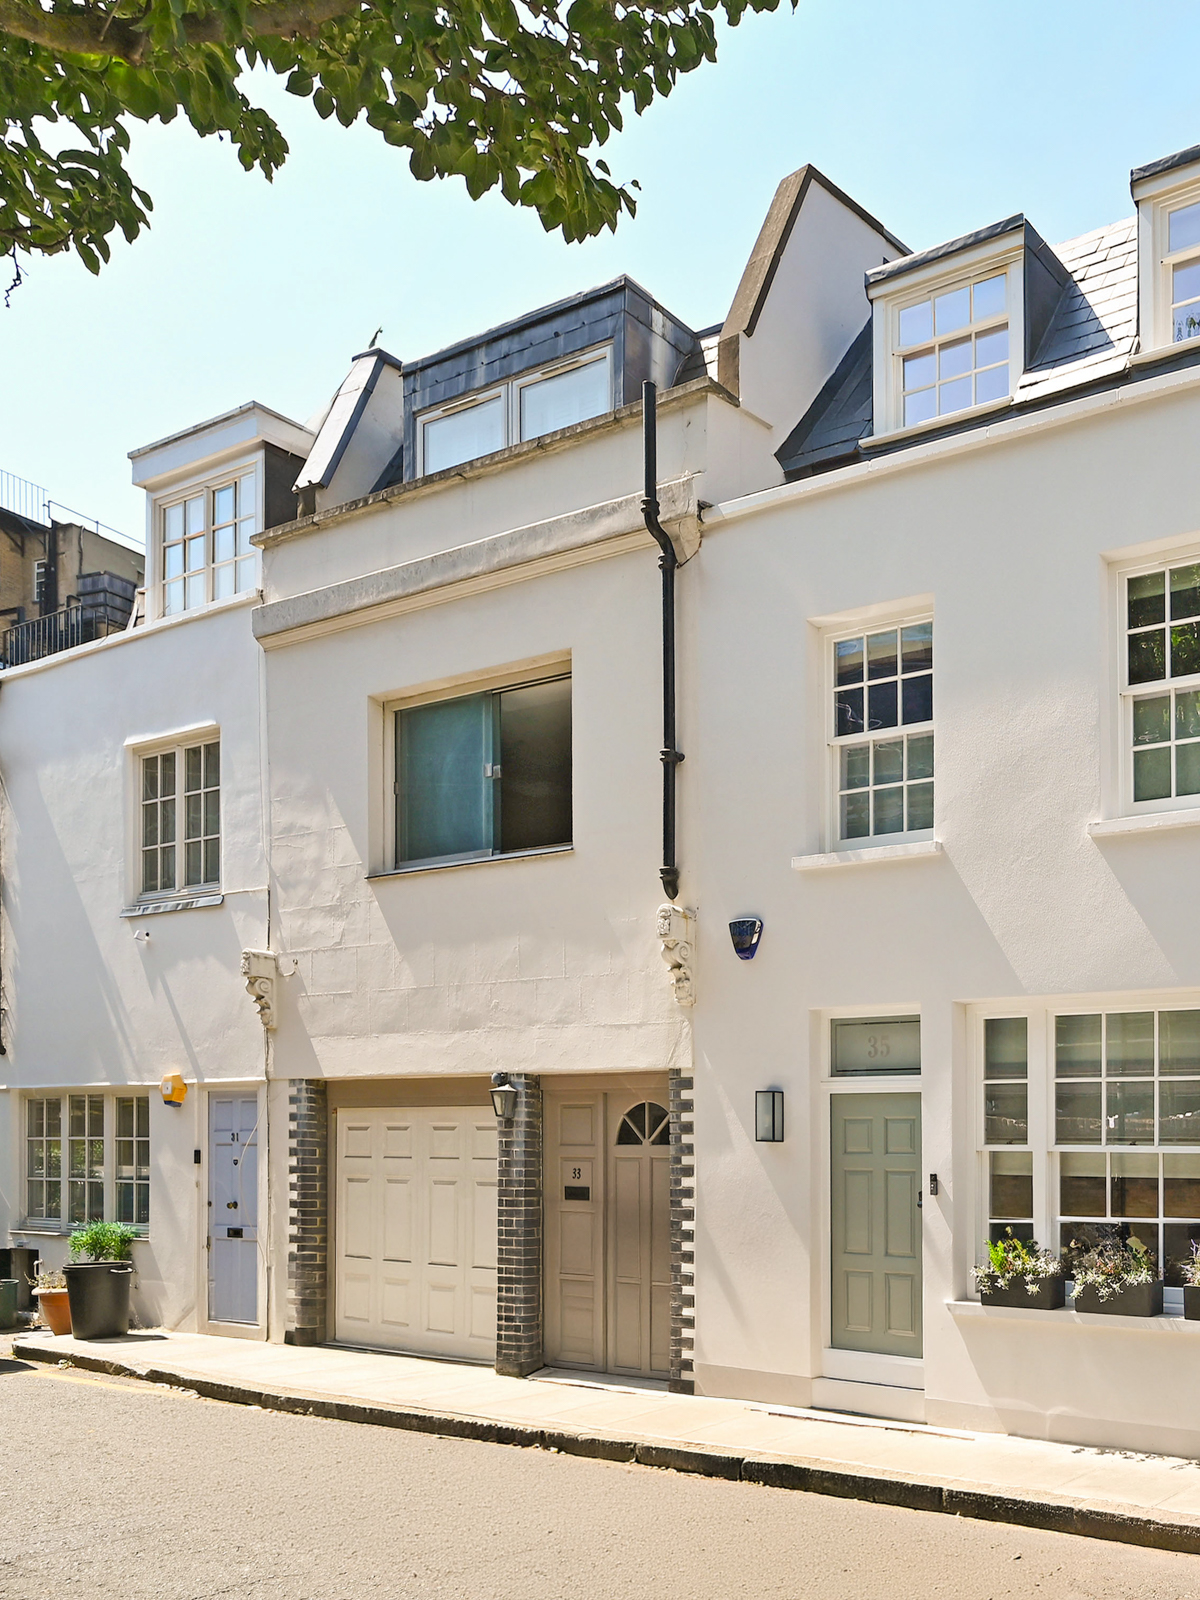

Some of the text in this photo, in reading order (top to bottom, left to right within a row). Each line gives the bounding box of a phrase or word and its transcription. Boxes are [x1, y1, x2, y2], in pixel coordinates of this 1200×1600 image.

[867, 1035, 891, 1059] 35
[230, 1132, 239, 1142] 31
[572, 1167, 582, 1180] 33
